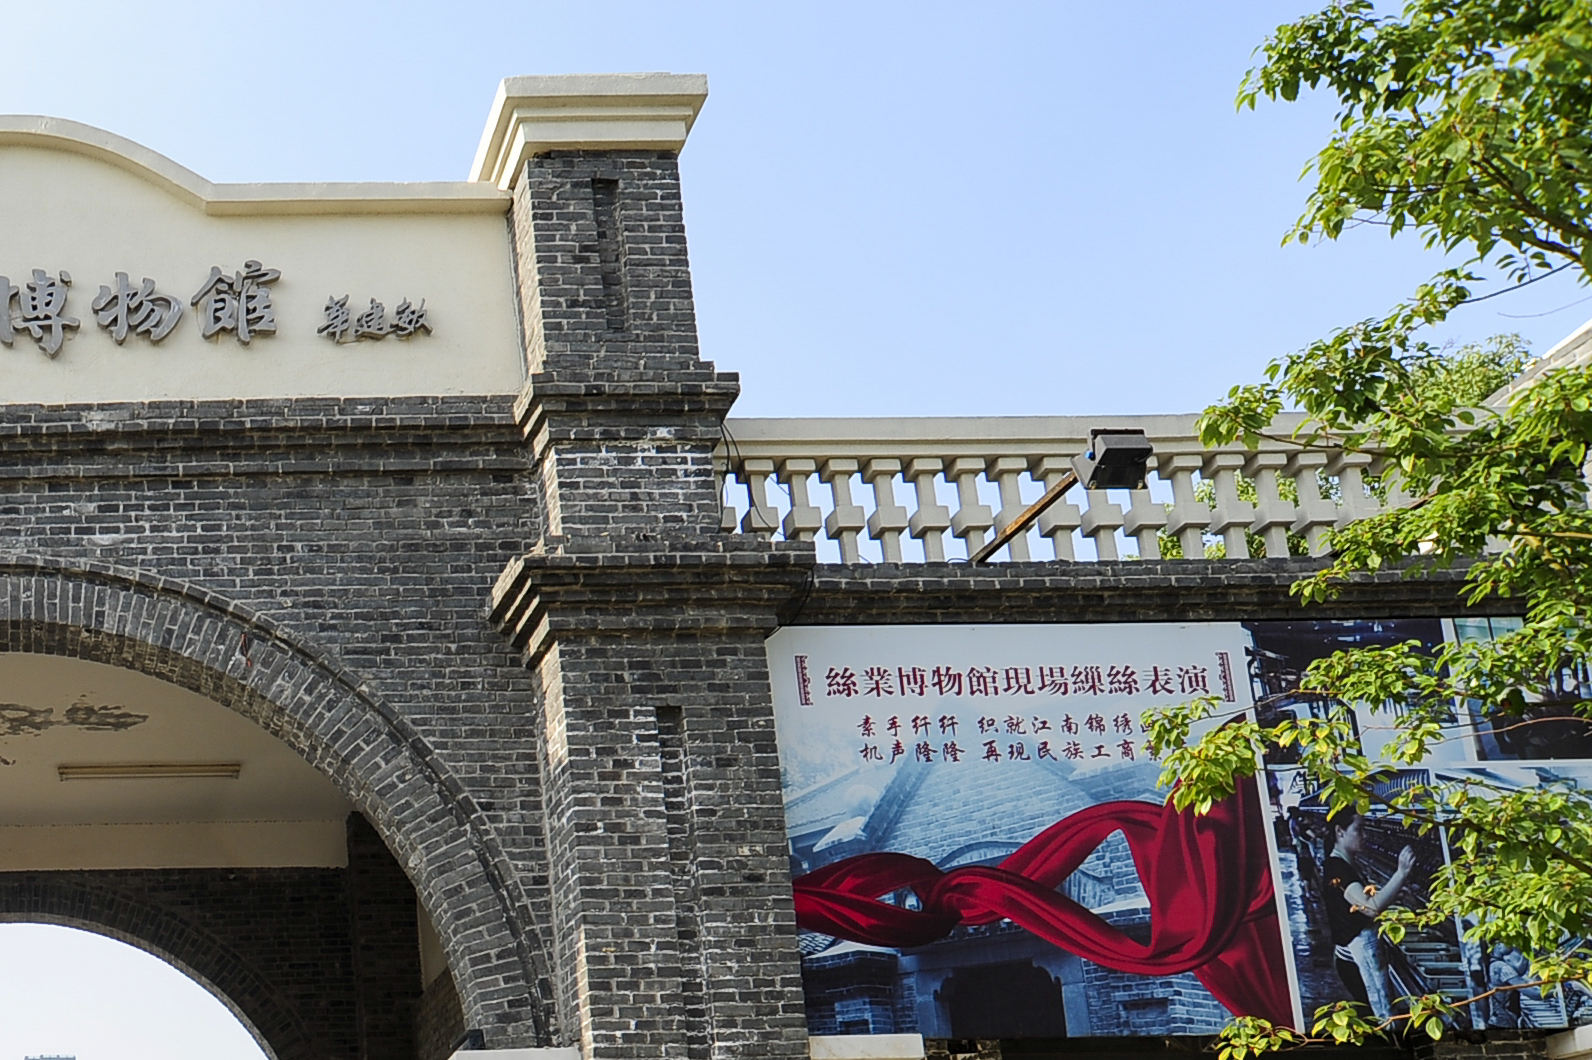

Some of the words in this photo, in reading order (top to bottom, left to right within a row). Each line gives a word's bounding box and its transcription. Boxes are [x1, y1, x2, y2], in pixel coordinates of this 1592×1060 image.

[856, 714, 959, 738] 素手纤纤
[859, 739, 965, 765] 机声隆隆
